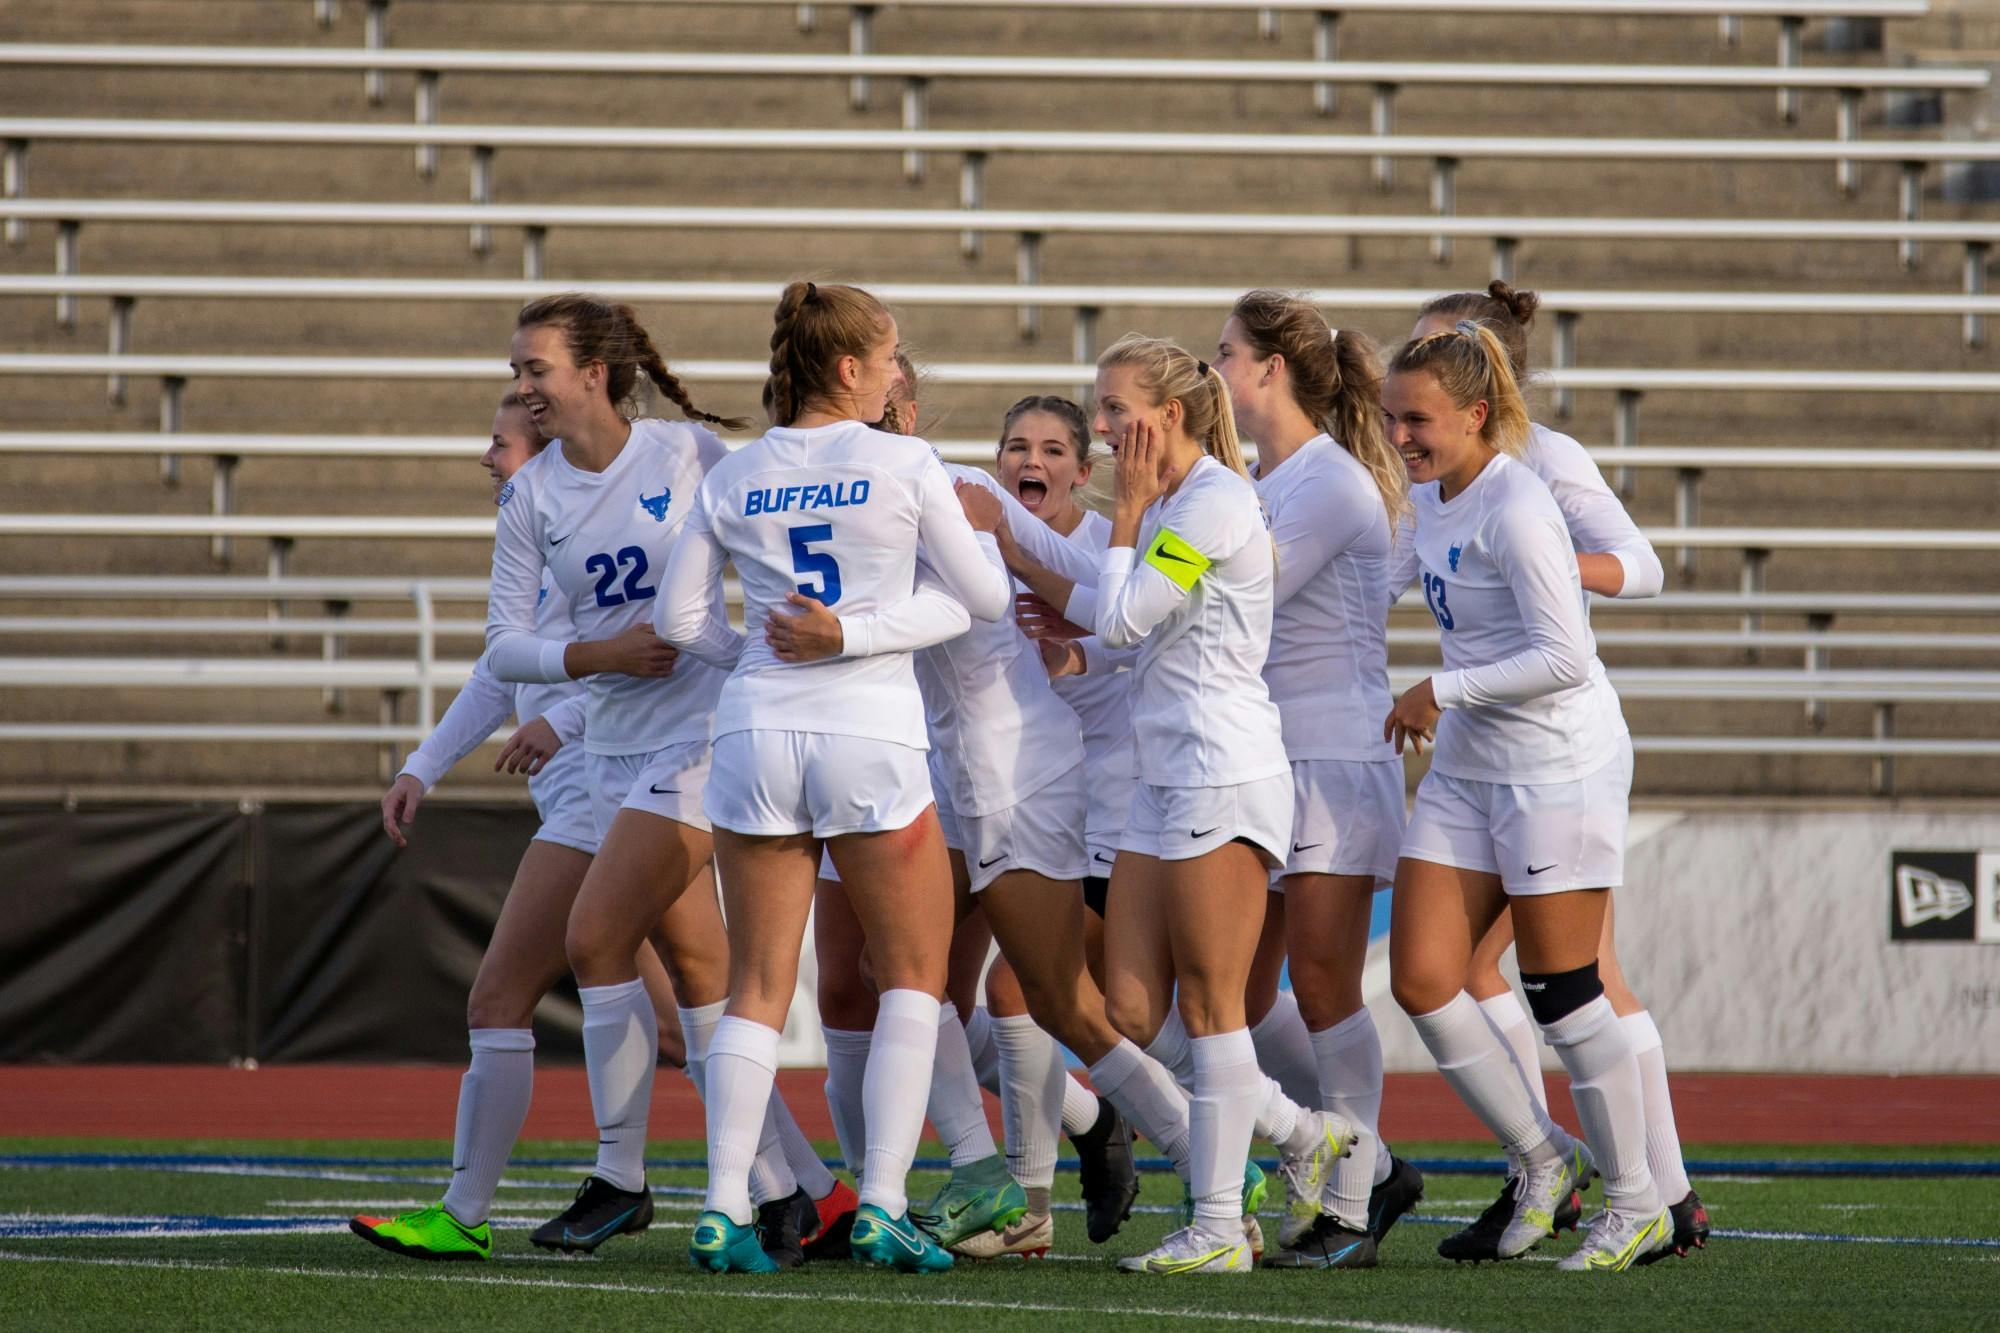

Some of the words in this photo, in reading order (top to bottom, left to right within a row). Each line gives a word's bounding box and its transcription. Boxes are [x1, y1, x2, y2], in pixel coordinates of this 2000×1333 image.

[744, 480, 870, 516] BUFFALO
[585, 546, 657, 607] 22
[788, 524, 842, 607] 5
[1423, 572, 1455, 631] 13
